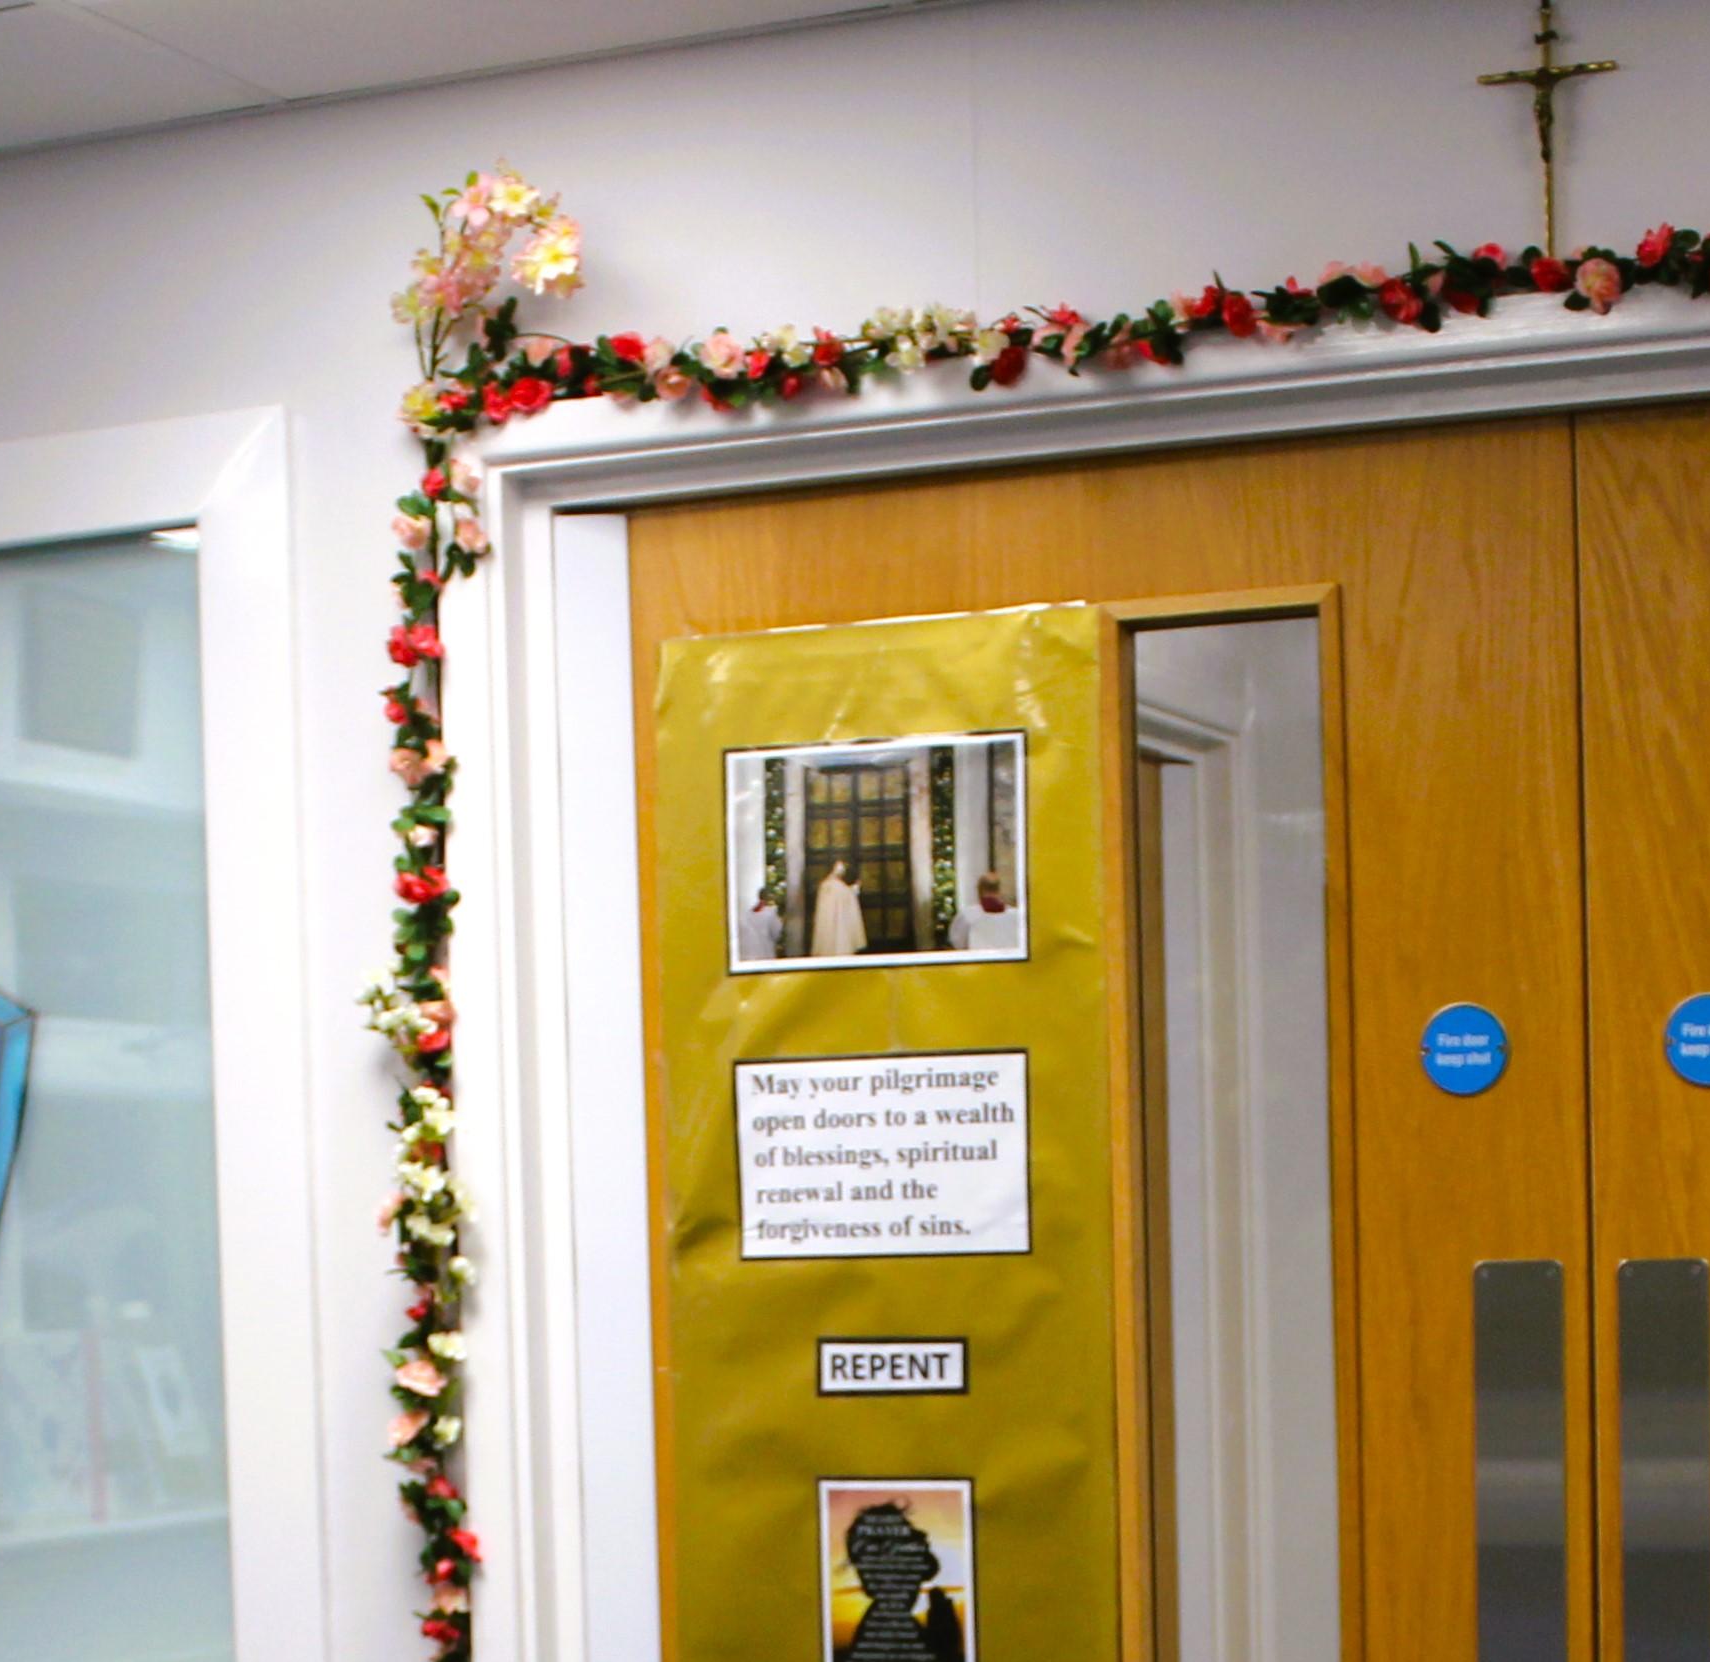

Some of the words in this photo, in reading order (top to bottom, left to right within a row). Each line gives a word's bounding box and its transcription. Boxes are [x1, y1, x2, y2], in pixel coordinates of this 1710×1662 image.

[752, 1074, 799, 1099] May
[809, 1074, 862, 1098] your
[870, 1067, 999, 1096] pilgrimage
[752, 1113, 806, 1136] open
[813, 1108, 877, 1129] doors
[884, 1109, 907, 1127] to
[914, 1110, 927, 1126] a
[934, 1101, 1014, 1125] wealth
[754, 1146, 776, 1168] of
[782, 1144, 889, 1170] blessings,
[896, 1139, 998, 1169] spiritual
[756, 1180, 843, 1205] renewal
[850, 1179, 893, 1201] and
[901, 1179, 938, 1200] the
[757, 1218, 882, 1244] forgiveness
[890, 1216, 914, 1237] of
[919, 1216, 972, 1237] sins.
[831, 1353, 951, 1381] REPENT
